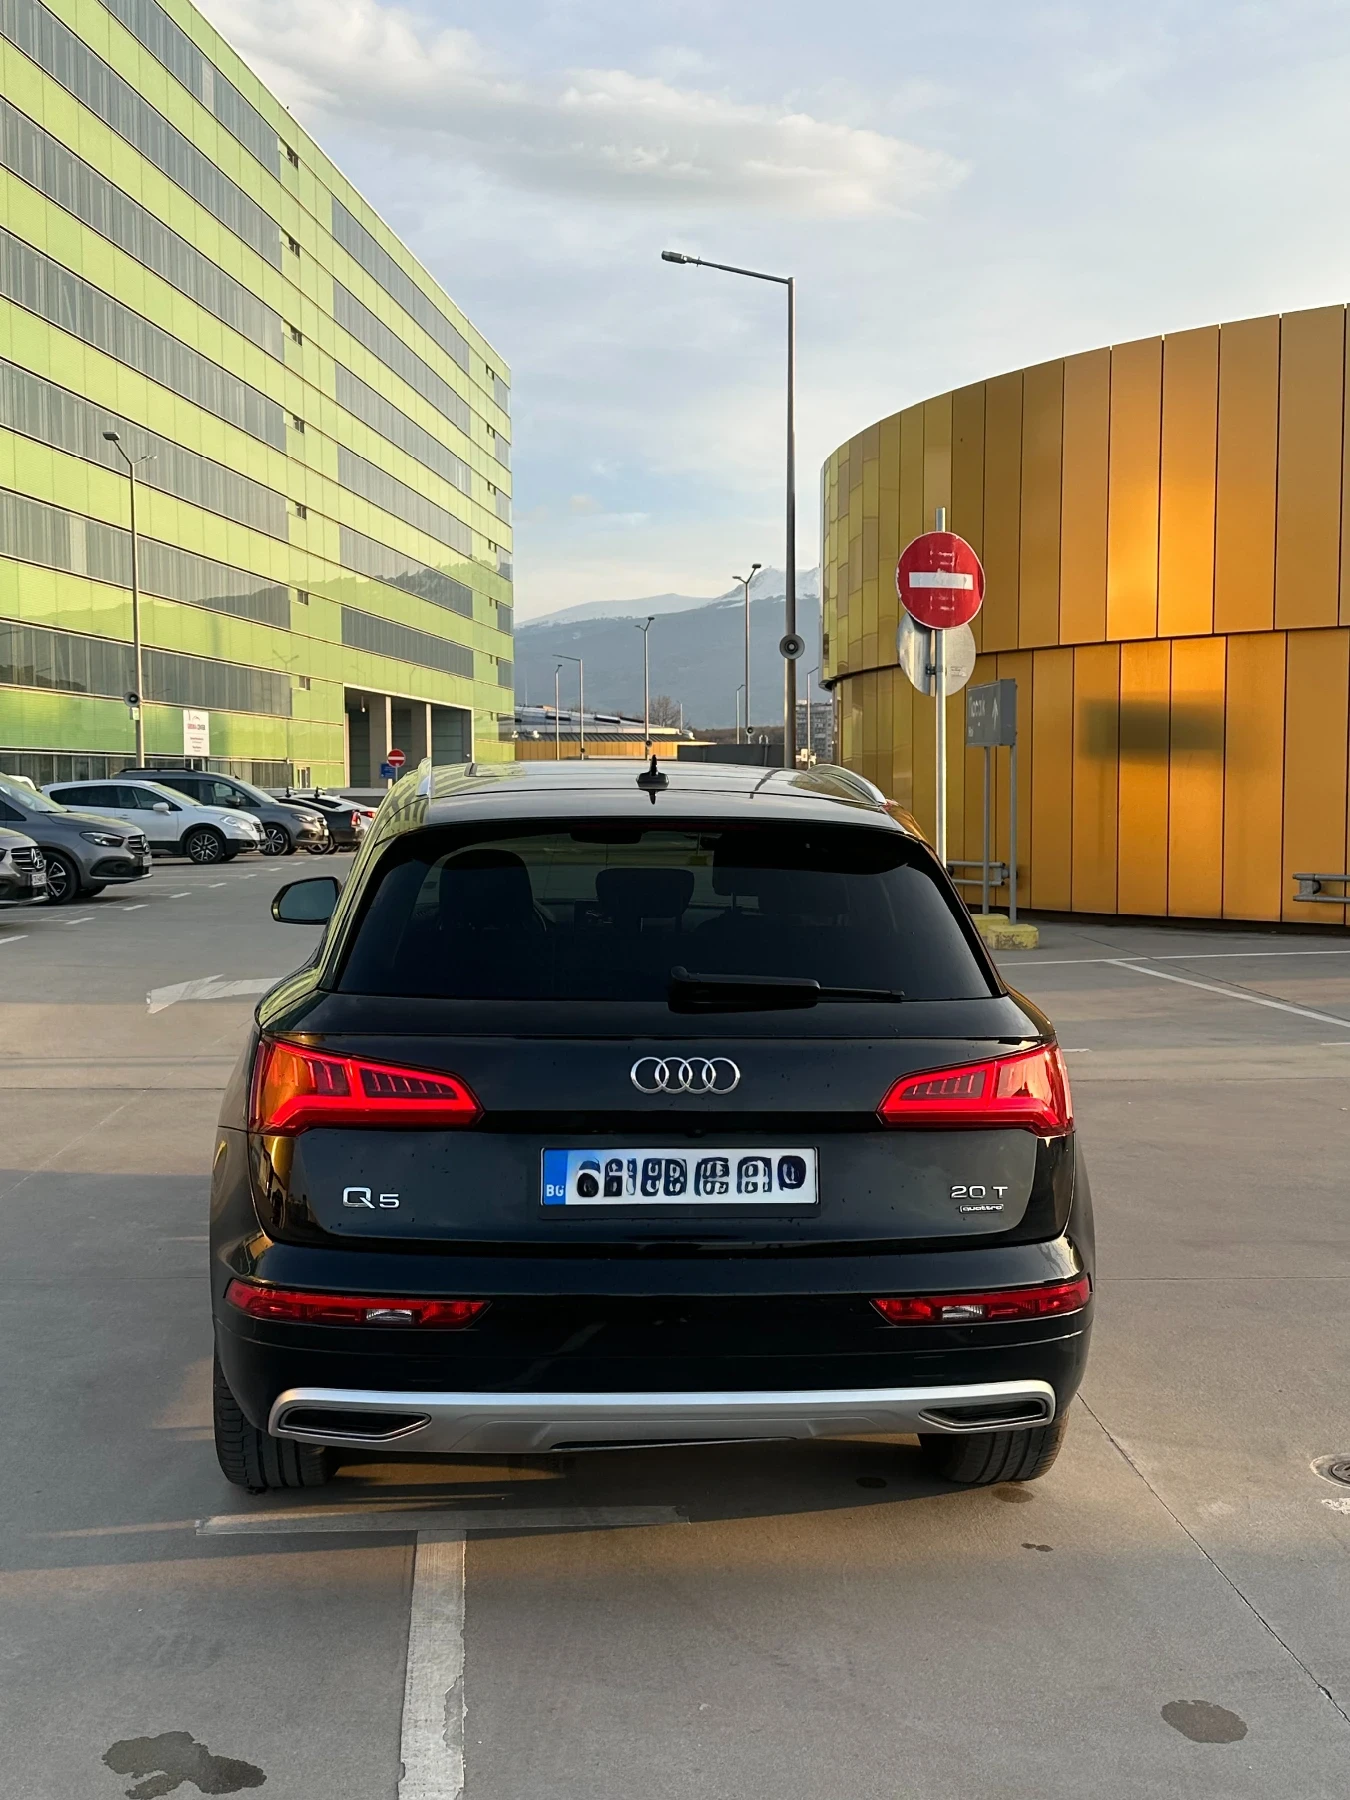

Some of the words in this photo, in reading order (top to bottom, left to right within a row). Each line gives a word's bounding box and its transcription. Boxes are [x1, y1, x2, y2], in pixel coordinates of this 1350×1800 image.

[546, 1184, 564, 1197] BG
[992, 1186, 1008, 1199] T
[343, 1187, 400, 1209] Q5
